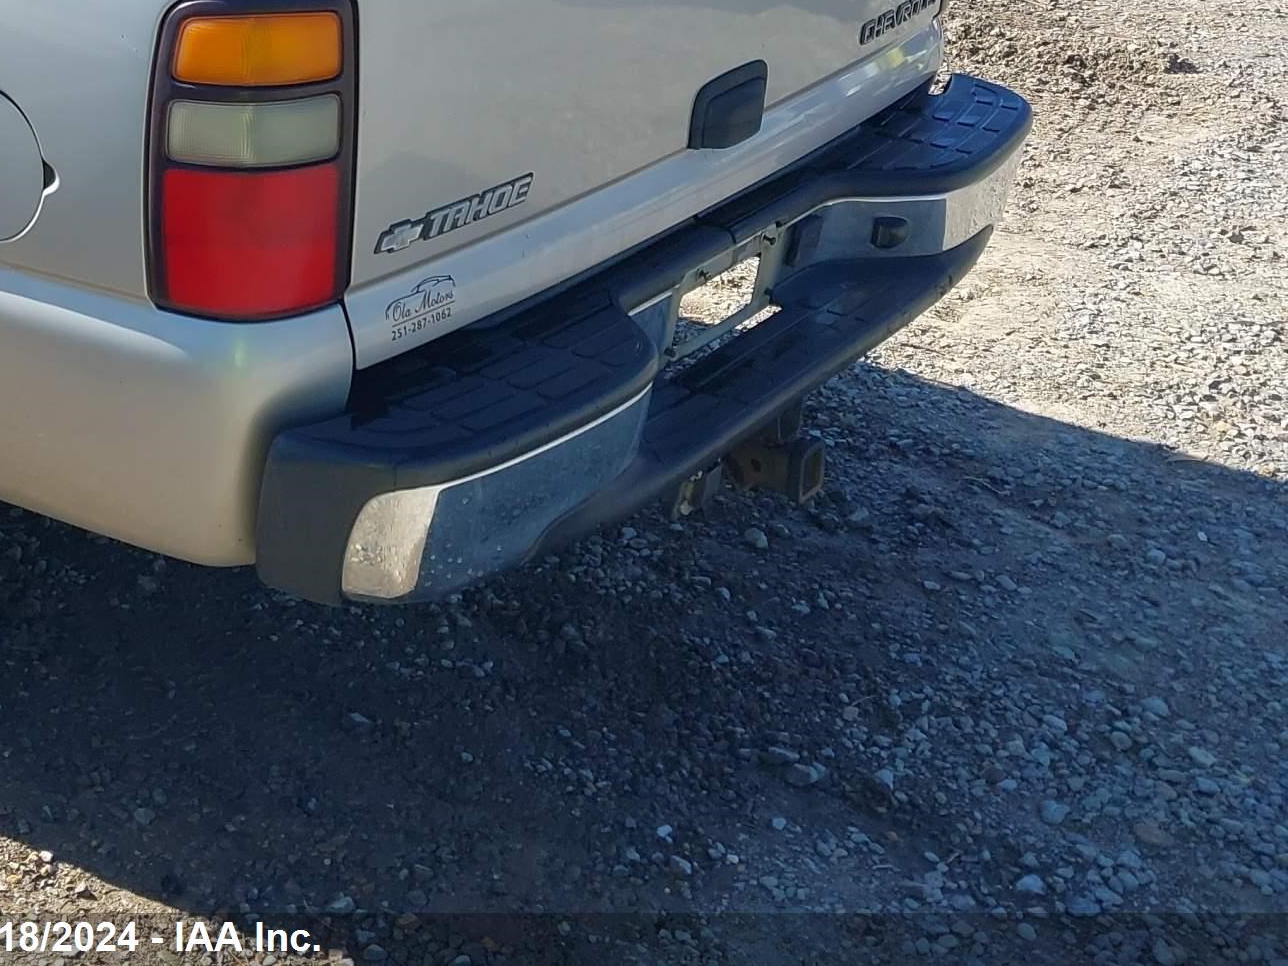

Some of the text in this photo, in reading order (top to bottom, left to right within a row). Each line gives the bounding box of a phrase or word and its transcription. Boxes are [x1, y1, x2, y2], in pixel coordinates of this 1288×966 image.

[423, 172, 534, 241] TAHOE
[392, 289, 454, 322] Ola Motors
[392, 308, 452, 341] 251-287-1062
